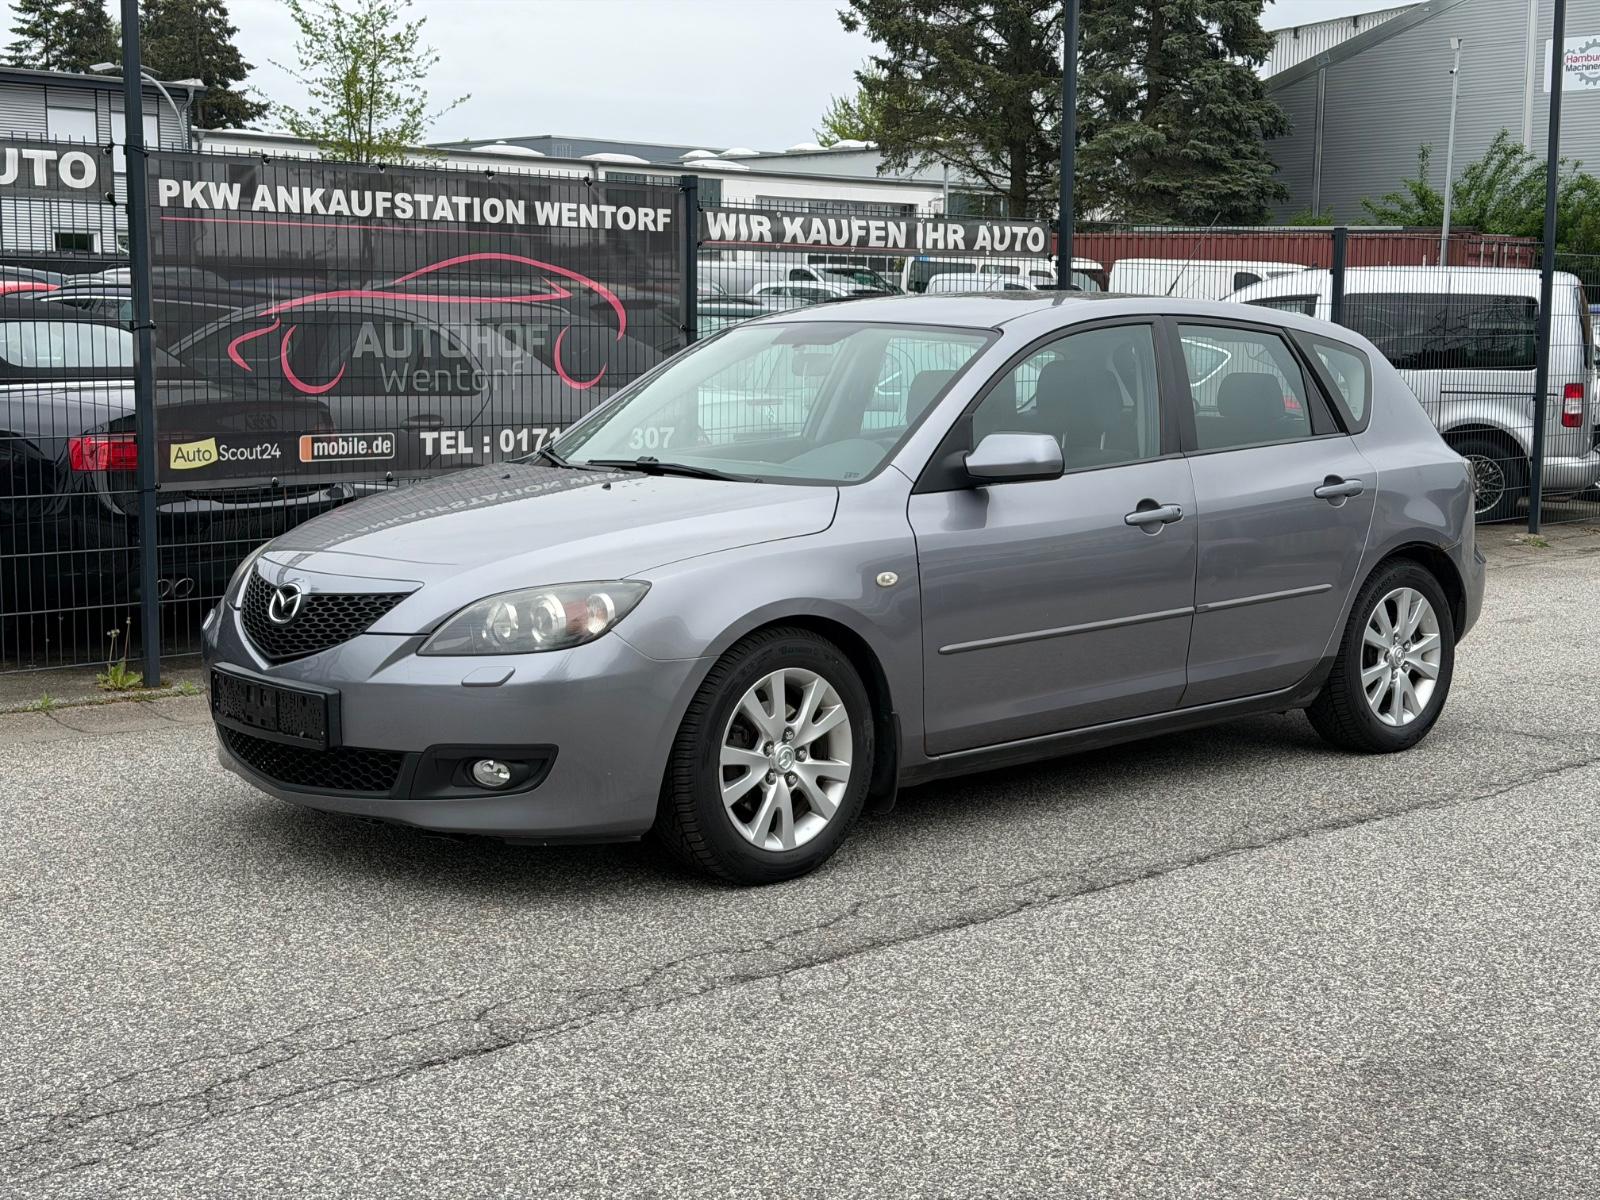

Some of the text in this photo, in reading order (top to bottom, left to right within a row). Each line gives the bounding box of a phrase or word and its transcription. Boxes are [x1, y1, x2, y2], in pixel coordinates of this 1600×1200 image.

[158, 179, 672, 232] PKW ANKAUFSTATION WENTORF
[706, 211, 1045, 252] WIR KAUFEN IHR AUTO
[352, 321, 549, 358] AUTOHOF
[380, 361, 525, 393] Wentorf
[313, 437, 391, 456] mobile.de
[629, 427, 675, 449] 307
